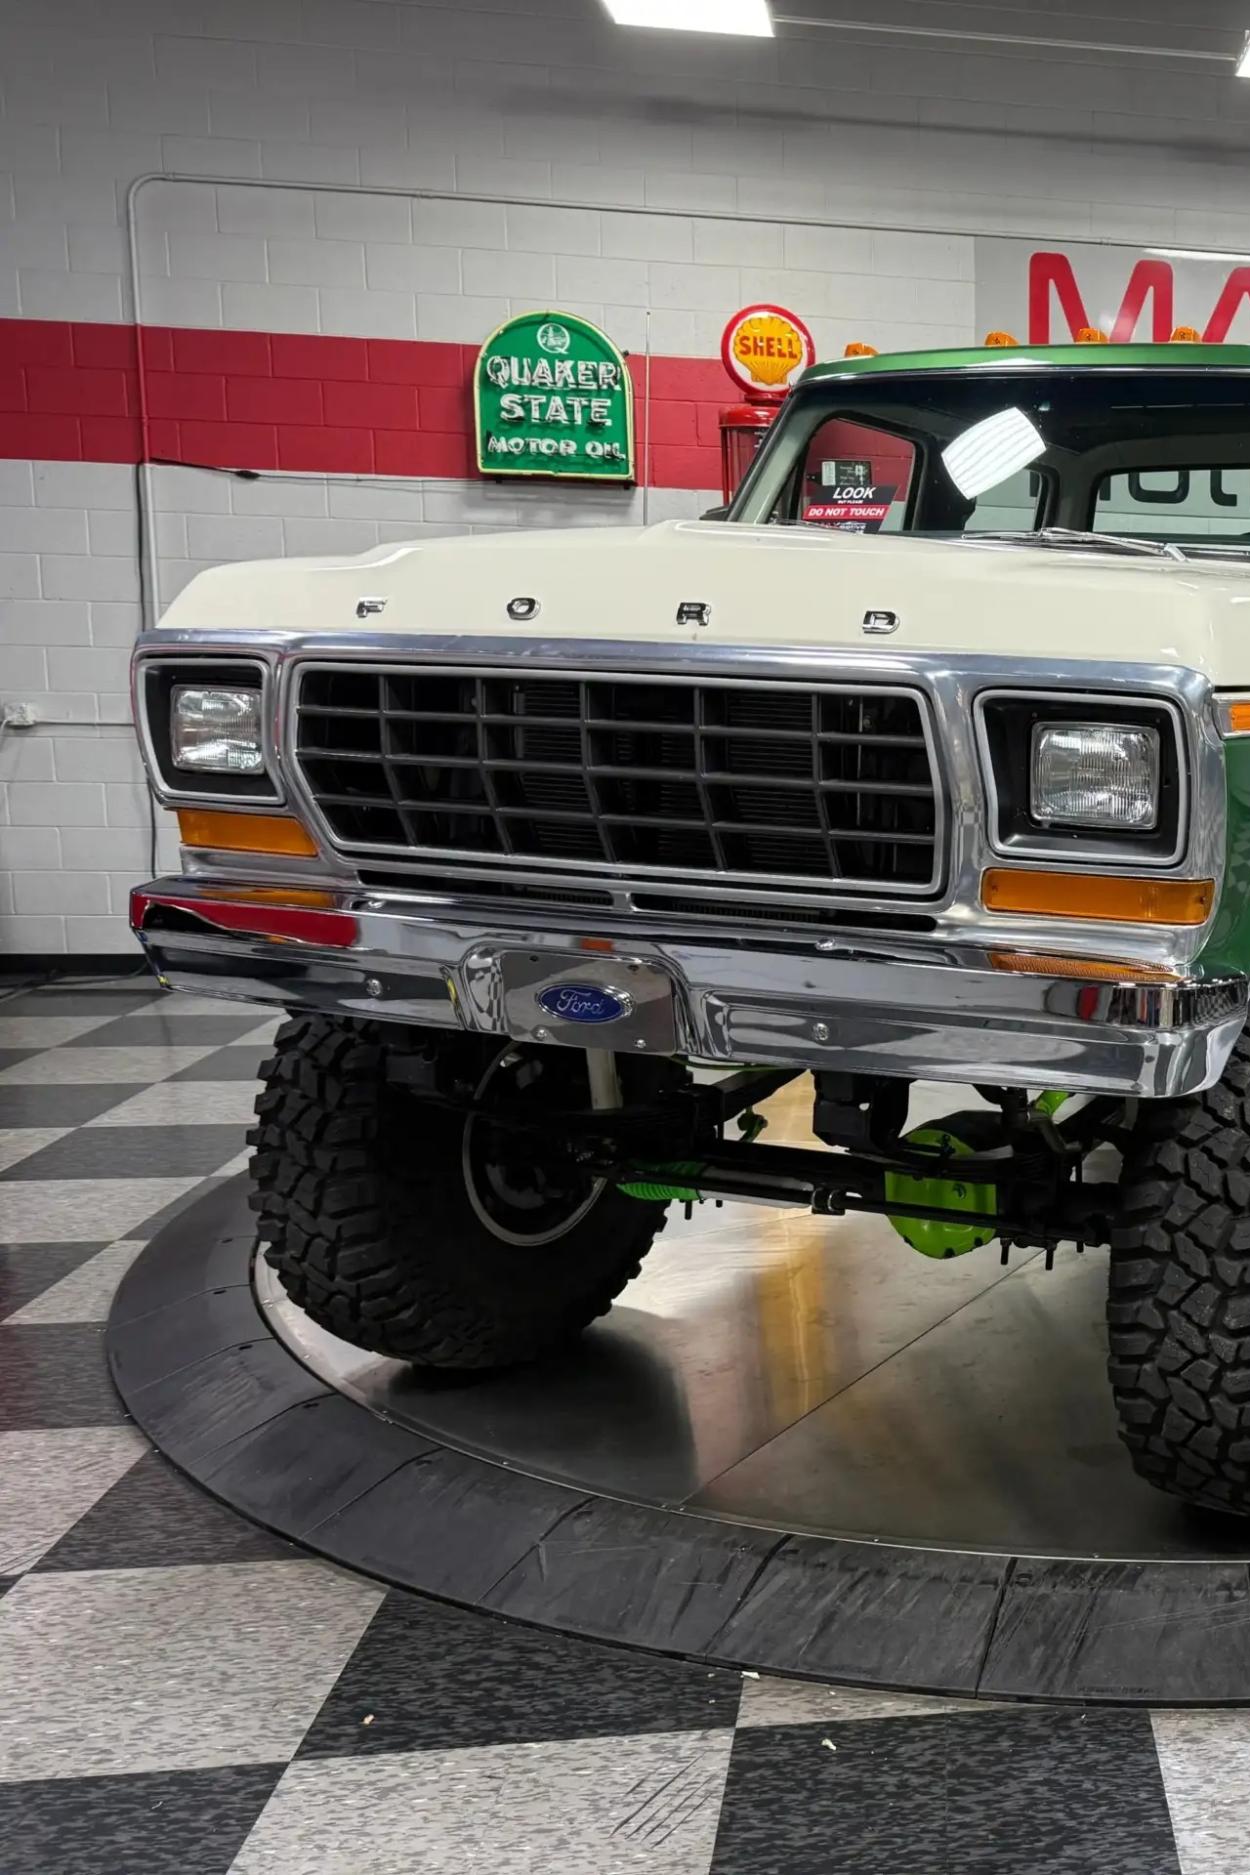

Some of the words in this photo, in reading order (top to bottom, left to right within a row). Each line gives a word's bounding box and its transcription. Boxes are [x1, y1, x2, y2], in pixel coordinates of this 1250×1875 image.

[739, 336, 798, 359] SHELL
[487, 356, 621, 390] QUAKER
[500, 394, 612, 426] STATE
[488, 437, 577, 456] MOTOR
[585, 441, 626, 460] OIL
[832, 487, 876, 499] LOOK
[808, 508, 823, 516] DO
[825, 508, 847, 516] NOT
[849, 508, 885, 516] TOUCH
[557, 988, 605, 1014] Ford
